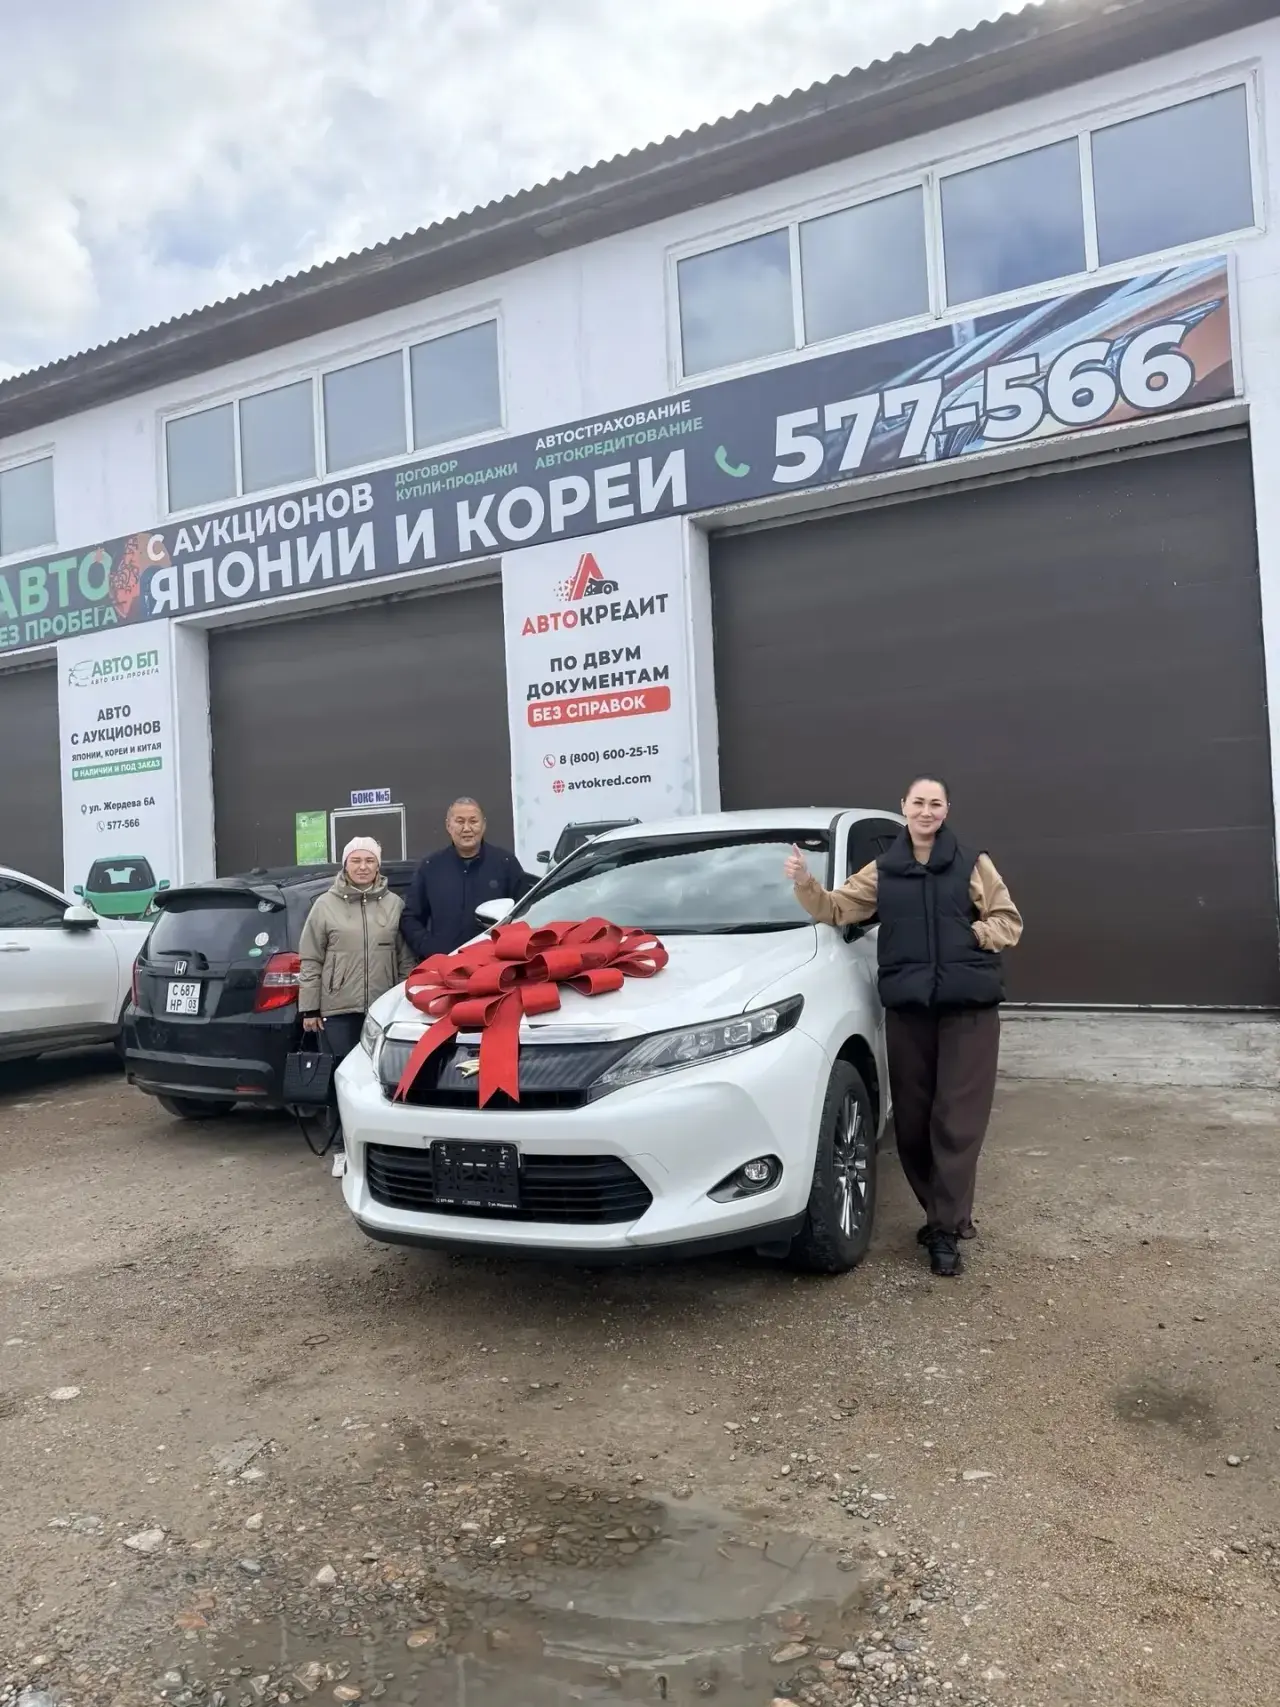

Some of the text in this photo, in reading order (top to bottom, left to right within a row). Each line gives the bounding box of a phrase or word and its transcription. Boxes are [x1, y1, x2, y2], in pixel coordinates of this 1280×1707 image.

[772, 325, 1195, 484] 577-566
[535, 400, 691, 451] АВТОСТРАХОВАНИЕ
[535, 417, 703, 470] АВТОКРЕДИТОВАНИЕ
[395, 459, 458, 486] ДОГОВОР
[396, 462, 518, 501] КУПЛИ-ПРОДАЖИ
[147, 483, 374, 561] С АУКЦИОНОВ
[150, 449, 688, 614] ЯПОНИИ И КОРЕИ
[0, 605, 118, 647] ЕЗ ПРОБЕГА
[521, 594, 669, 636] АВТОКРЕДИТ
[91, 649, 159, 677] АВТО БП
[550, 645, 642, 673] ПО ДВУМ
[91, 667, 160, 685] АВТО БЕЗ ПРОБЕГА
[526, 665, 670, 701] ДОКУМЕНТАМ
[97, 704, 131, 722] АВТО
[532, 694, 647, 722] БЕЗ СПРАВОК
[70, 720, 161, 746] С АУКЦИОНОВ
[71, 742, 162, 762] ЯПОНИИ, КОРЕИ И КИТАЯ
[559, 744, 660, 766] 8 (800) 600-25-15
[73, 759, 161, 778] В НАЛИЧИИ И ПОД ЗАКАЗ
[567, 773, 652, 791] avtokred.com
[89, 796, 156, 815] ул. Жердева 6А
[352, 790, 390, 804] БОКС №5
[107, 818, 140, 831] 577-566
[172, 984, 195, 996] С 687
[170, 999, 197, 1011] НР 03
